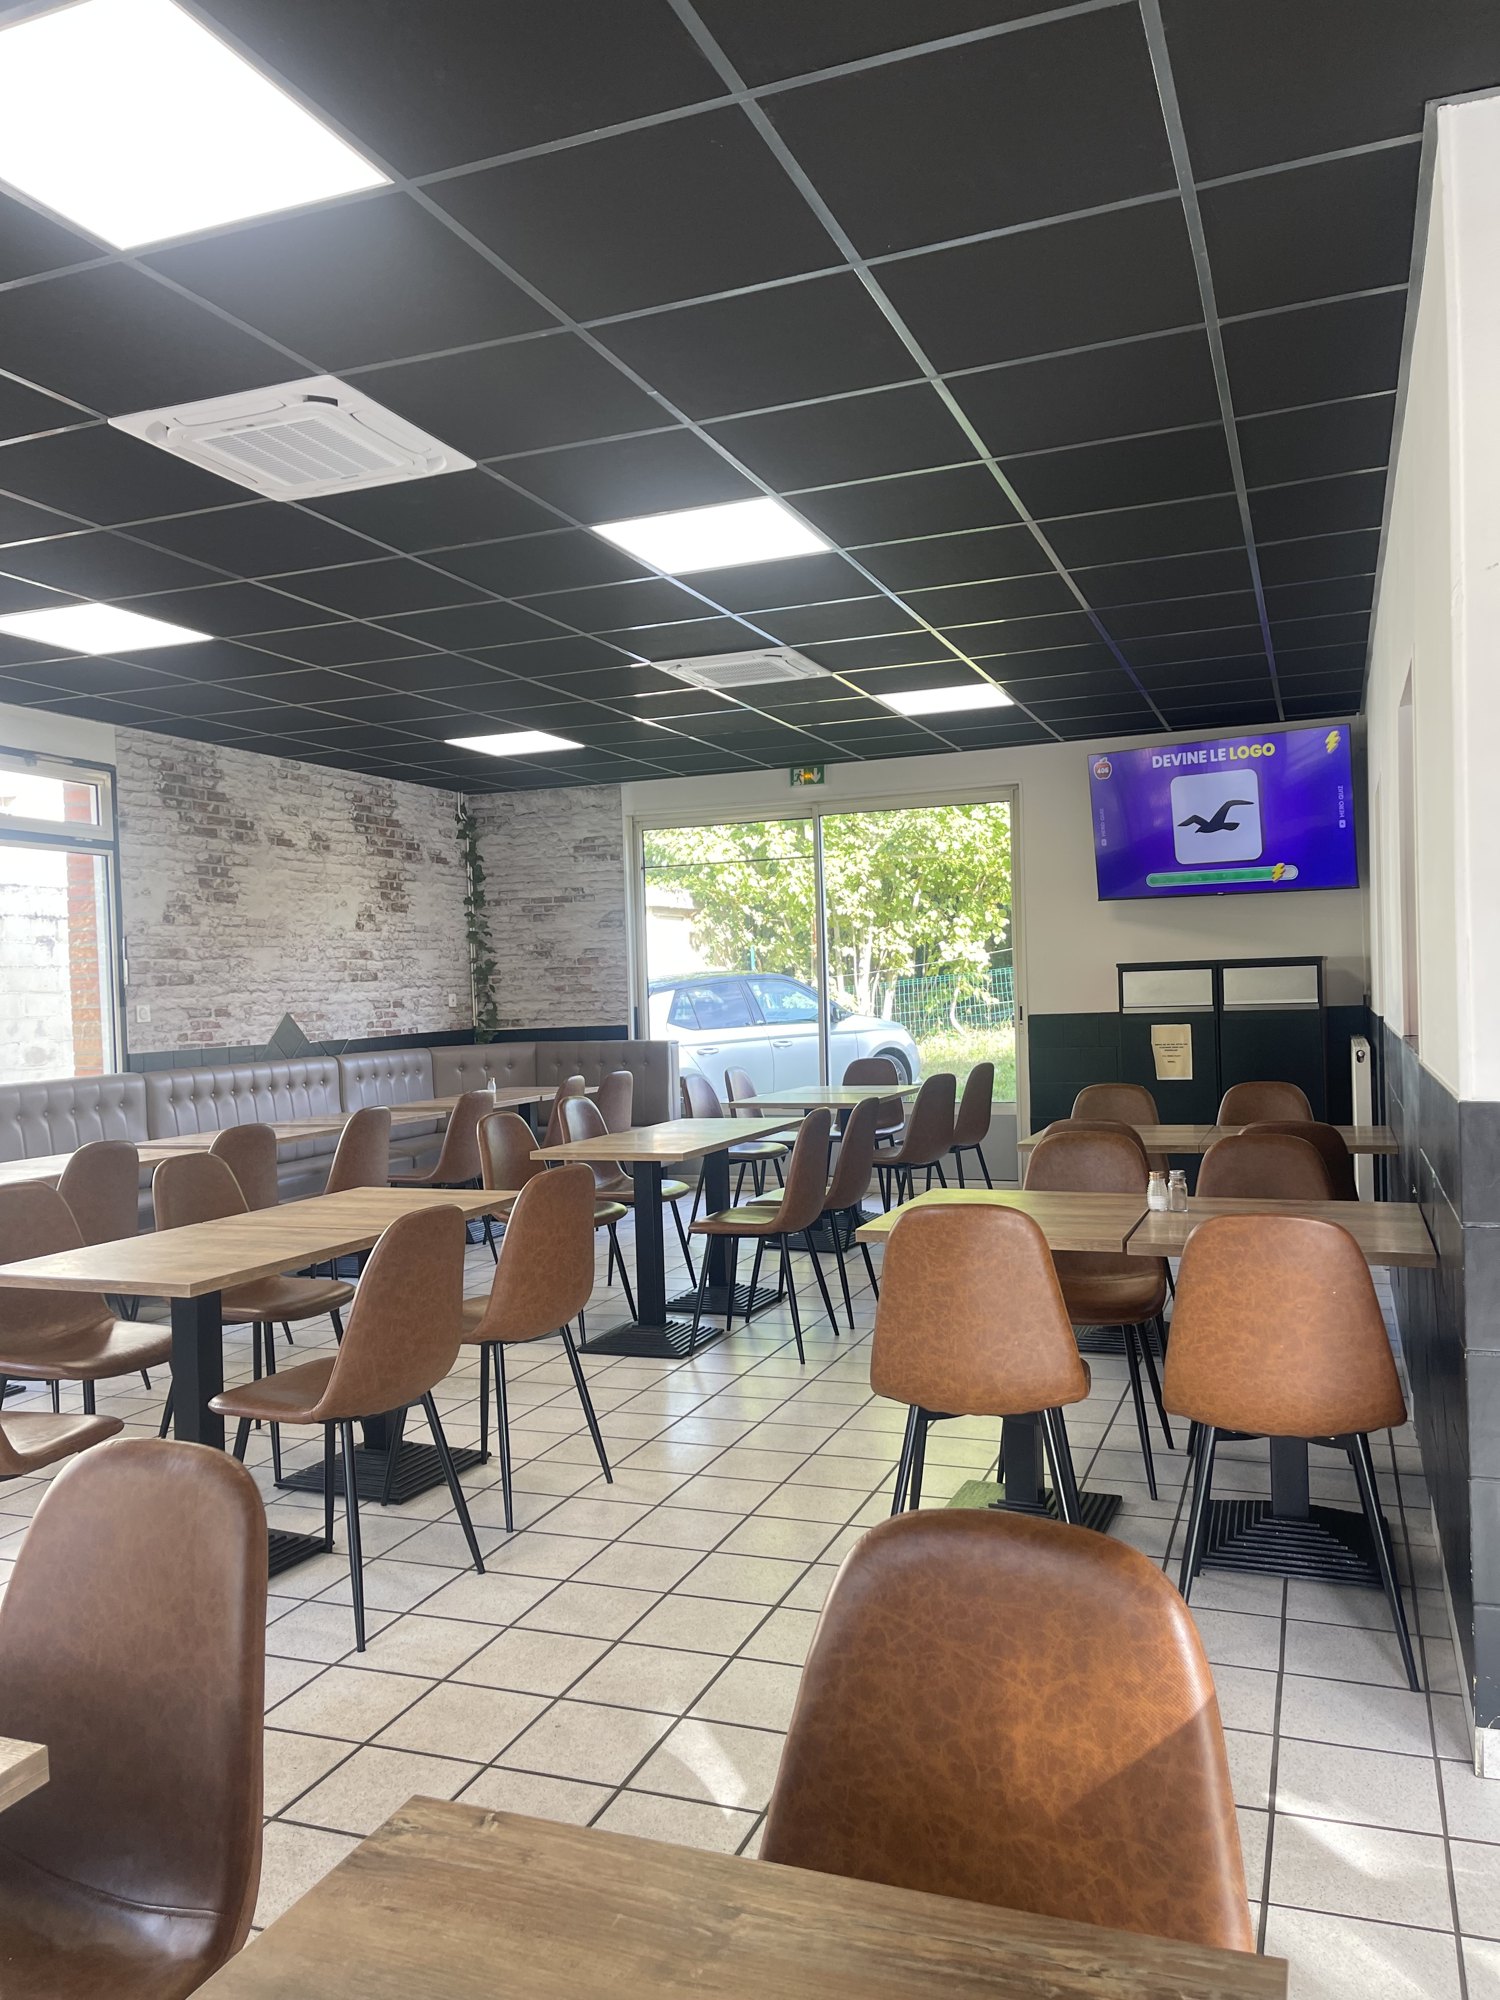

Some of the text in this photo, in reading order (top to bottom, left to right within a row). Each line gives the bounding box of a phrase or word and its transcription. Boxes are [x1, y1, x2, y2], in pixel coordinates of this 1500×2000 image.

[1152, 742, 1275, 769] DEVINE LE LOGO
